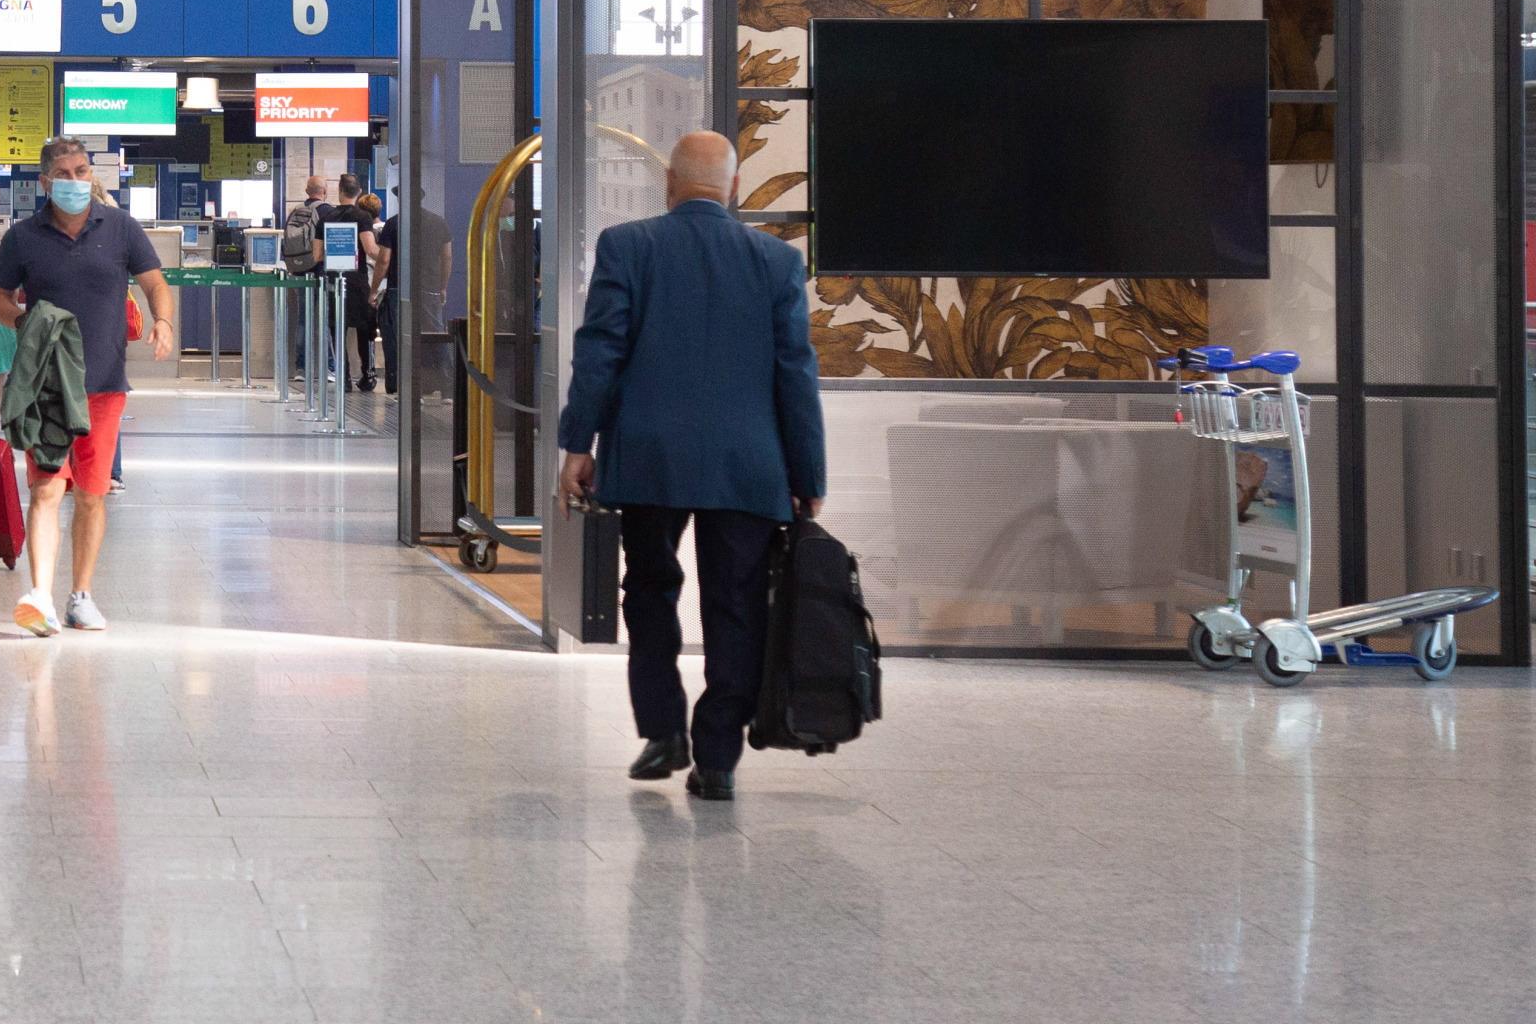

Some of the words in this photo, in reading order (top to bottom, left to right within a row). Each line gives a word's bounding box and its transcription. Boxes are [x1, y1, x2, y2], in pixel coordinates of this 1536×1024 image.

[68, 99, 128, 110] ECONOMY
[259, 96, 293, 108] SKY
[259, 107, 335, 119] PRIORITY
